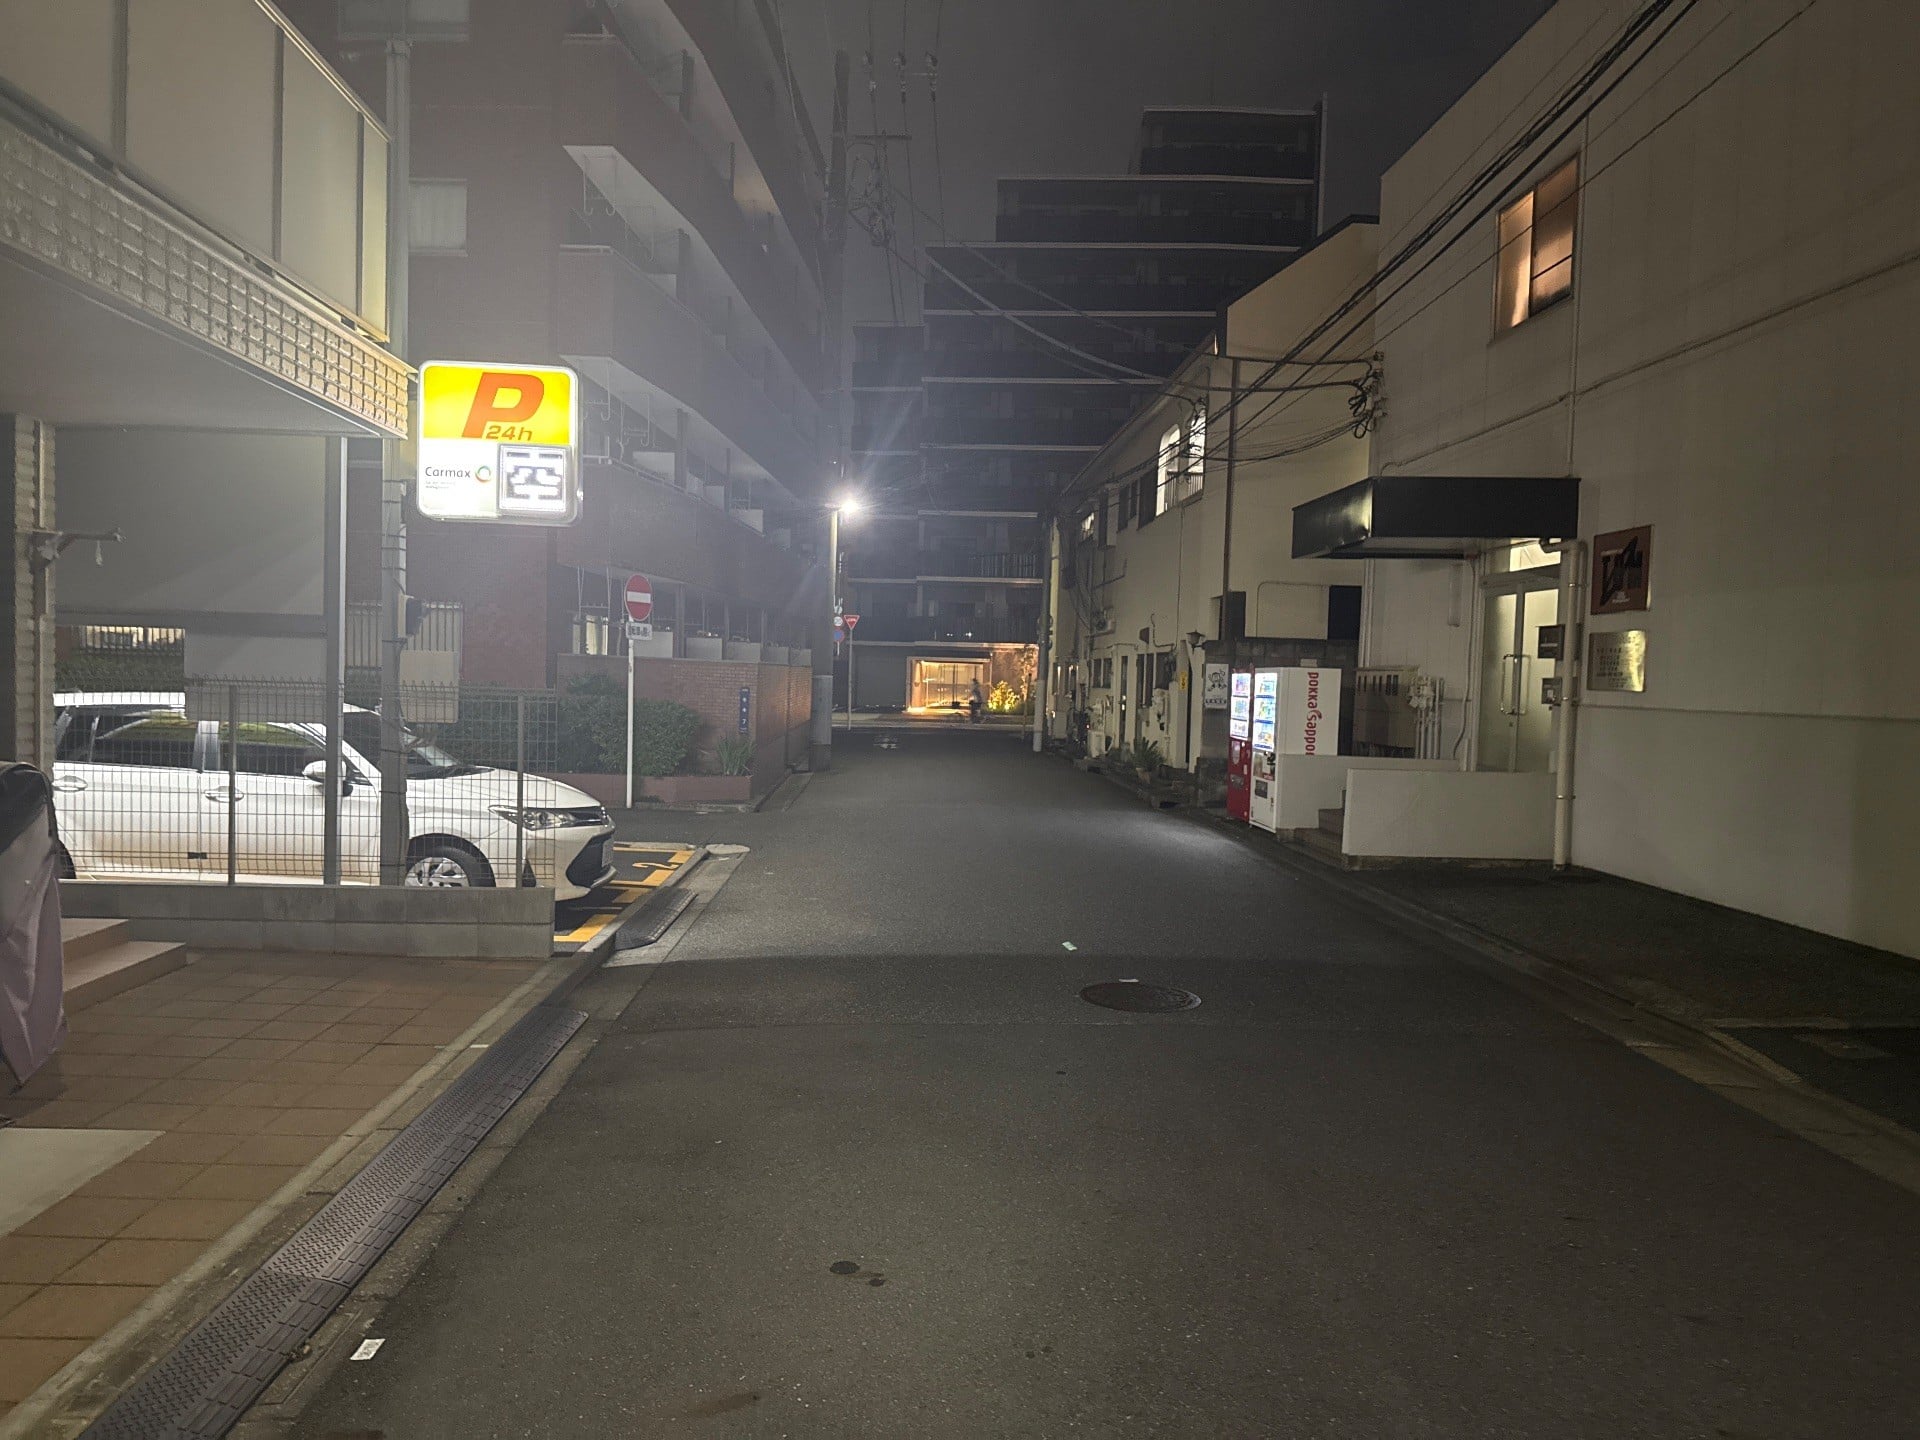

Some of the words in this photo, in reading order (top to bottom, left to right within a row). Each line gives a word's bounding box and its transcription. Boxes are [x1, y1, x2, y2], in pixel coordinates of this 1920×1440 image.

[461, 371, 545, 439] P
[485, 425, 533, 441] 24h
[425, 466, 471, 479] Carmax
